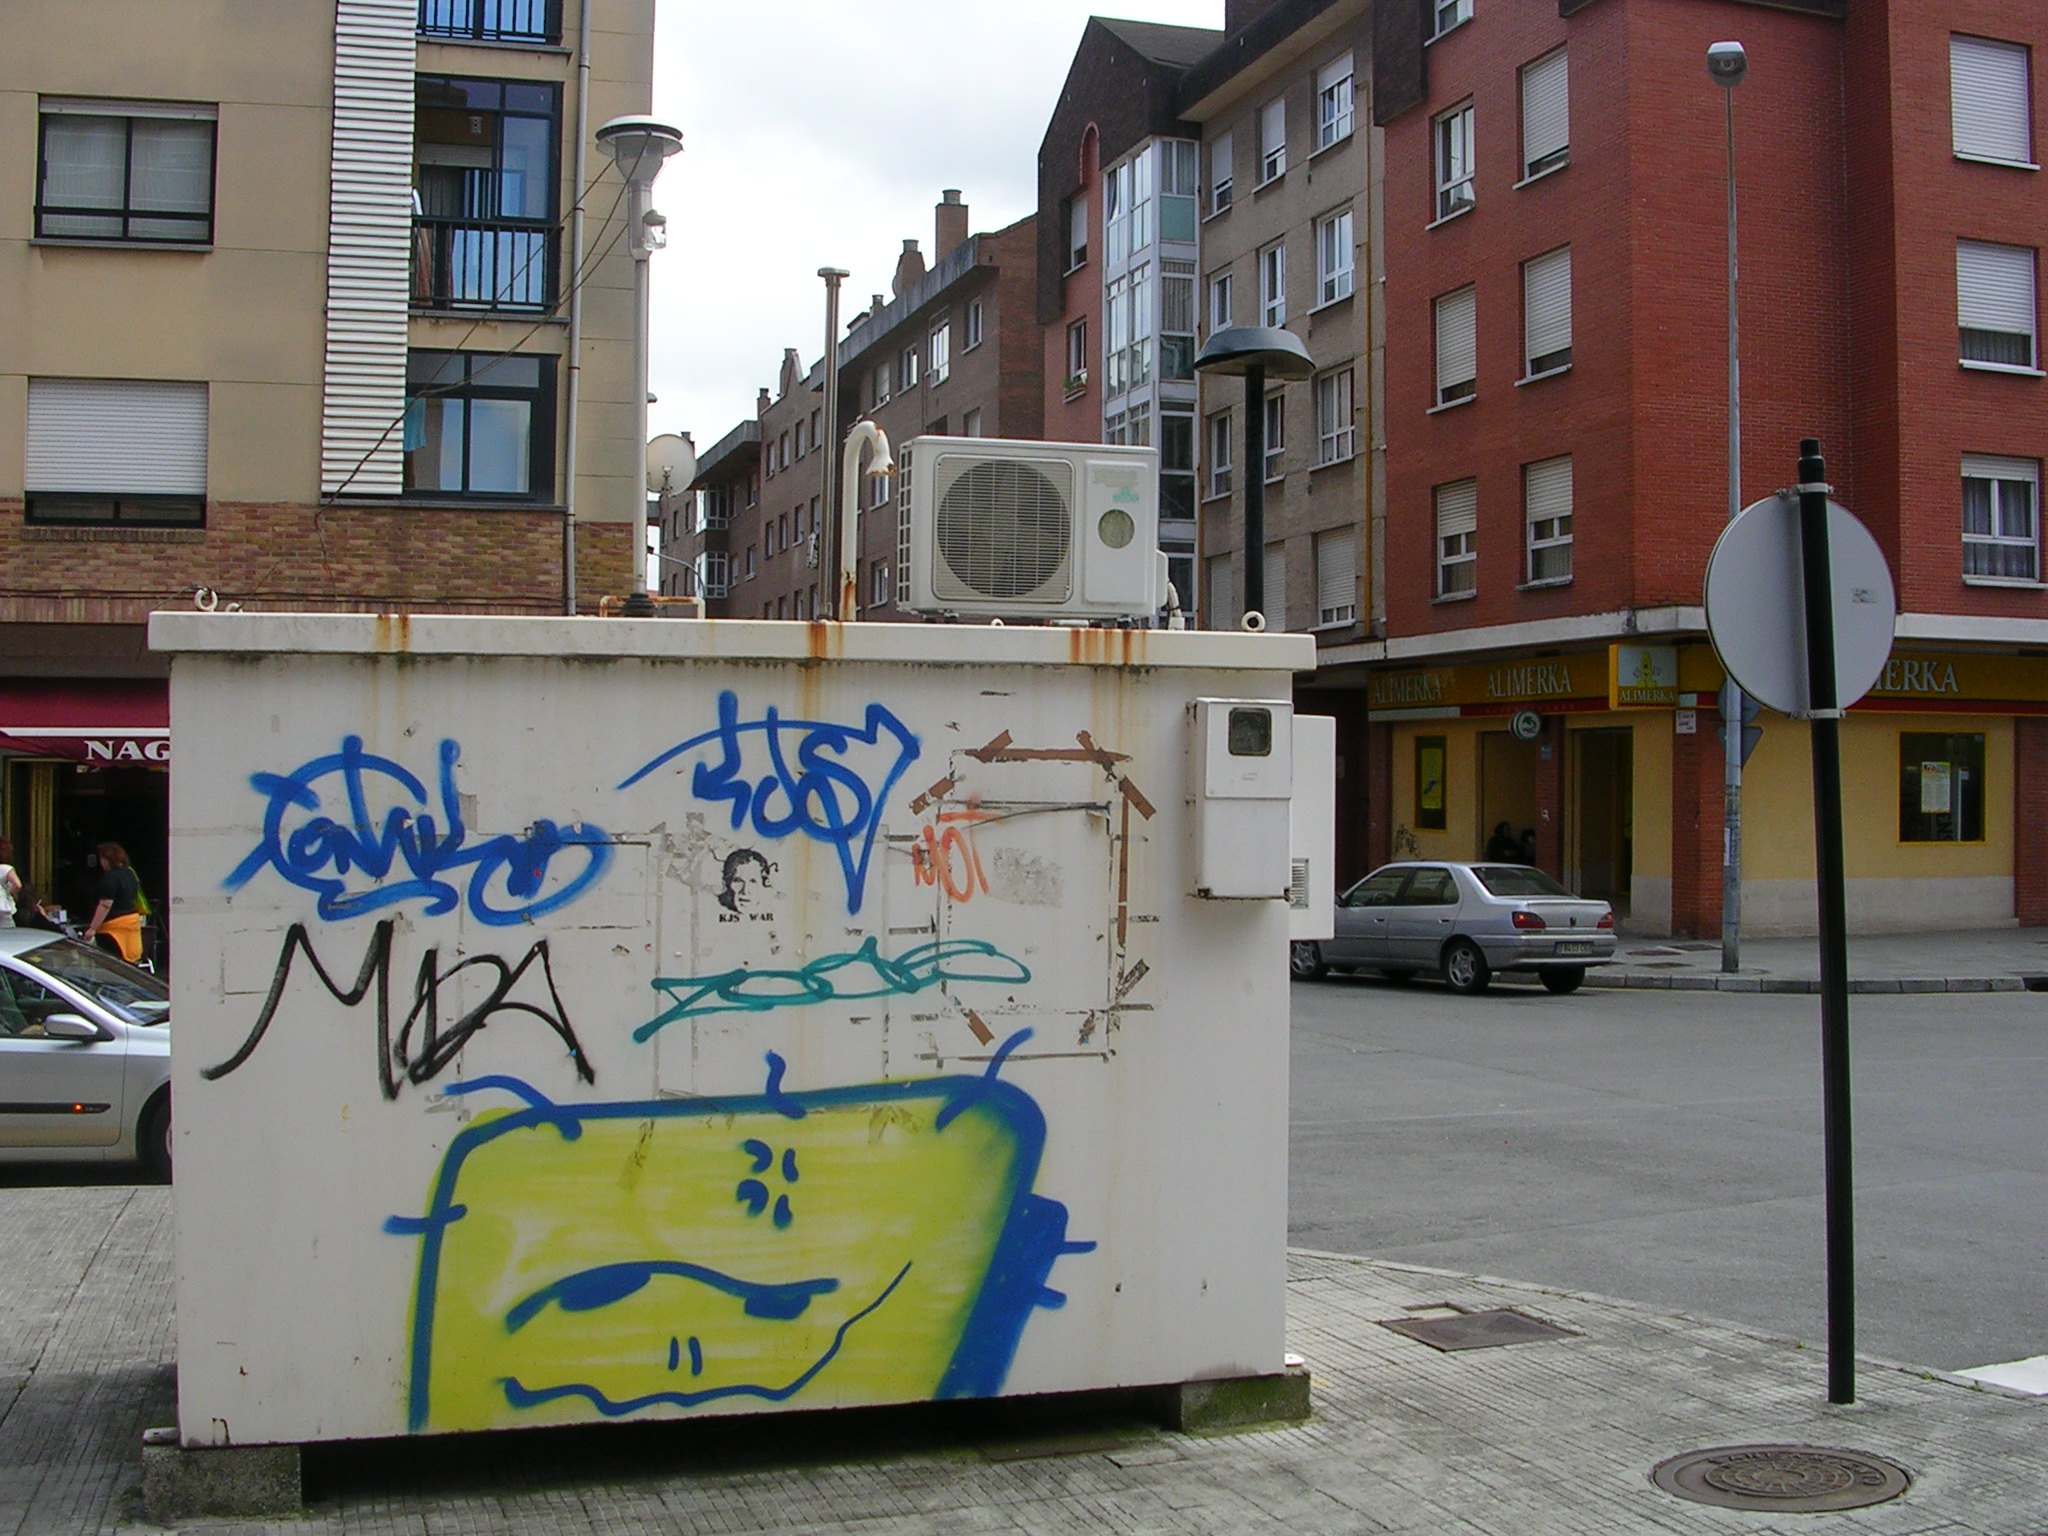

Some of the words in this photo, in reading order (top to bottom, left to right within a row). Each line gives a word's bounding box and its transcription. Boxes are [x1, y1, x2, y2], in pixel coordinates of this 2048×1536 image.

[1373, 673, 1442, 703] ALIMERKA
[1487, 664, 1573, 697] ALIMERKA
[1620, 689, 1675, 702] ALIMERKA
[749, 913, 774, 922] WAR
